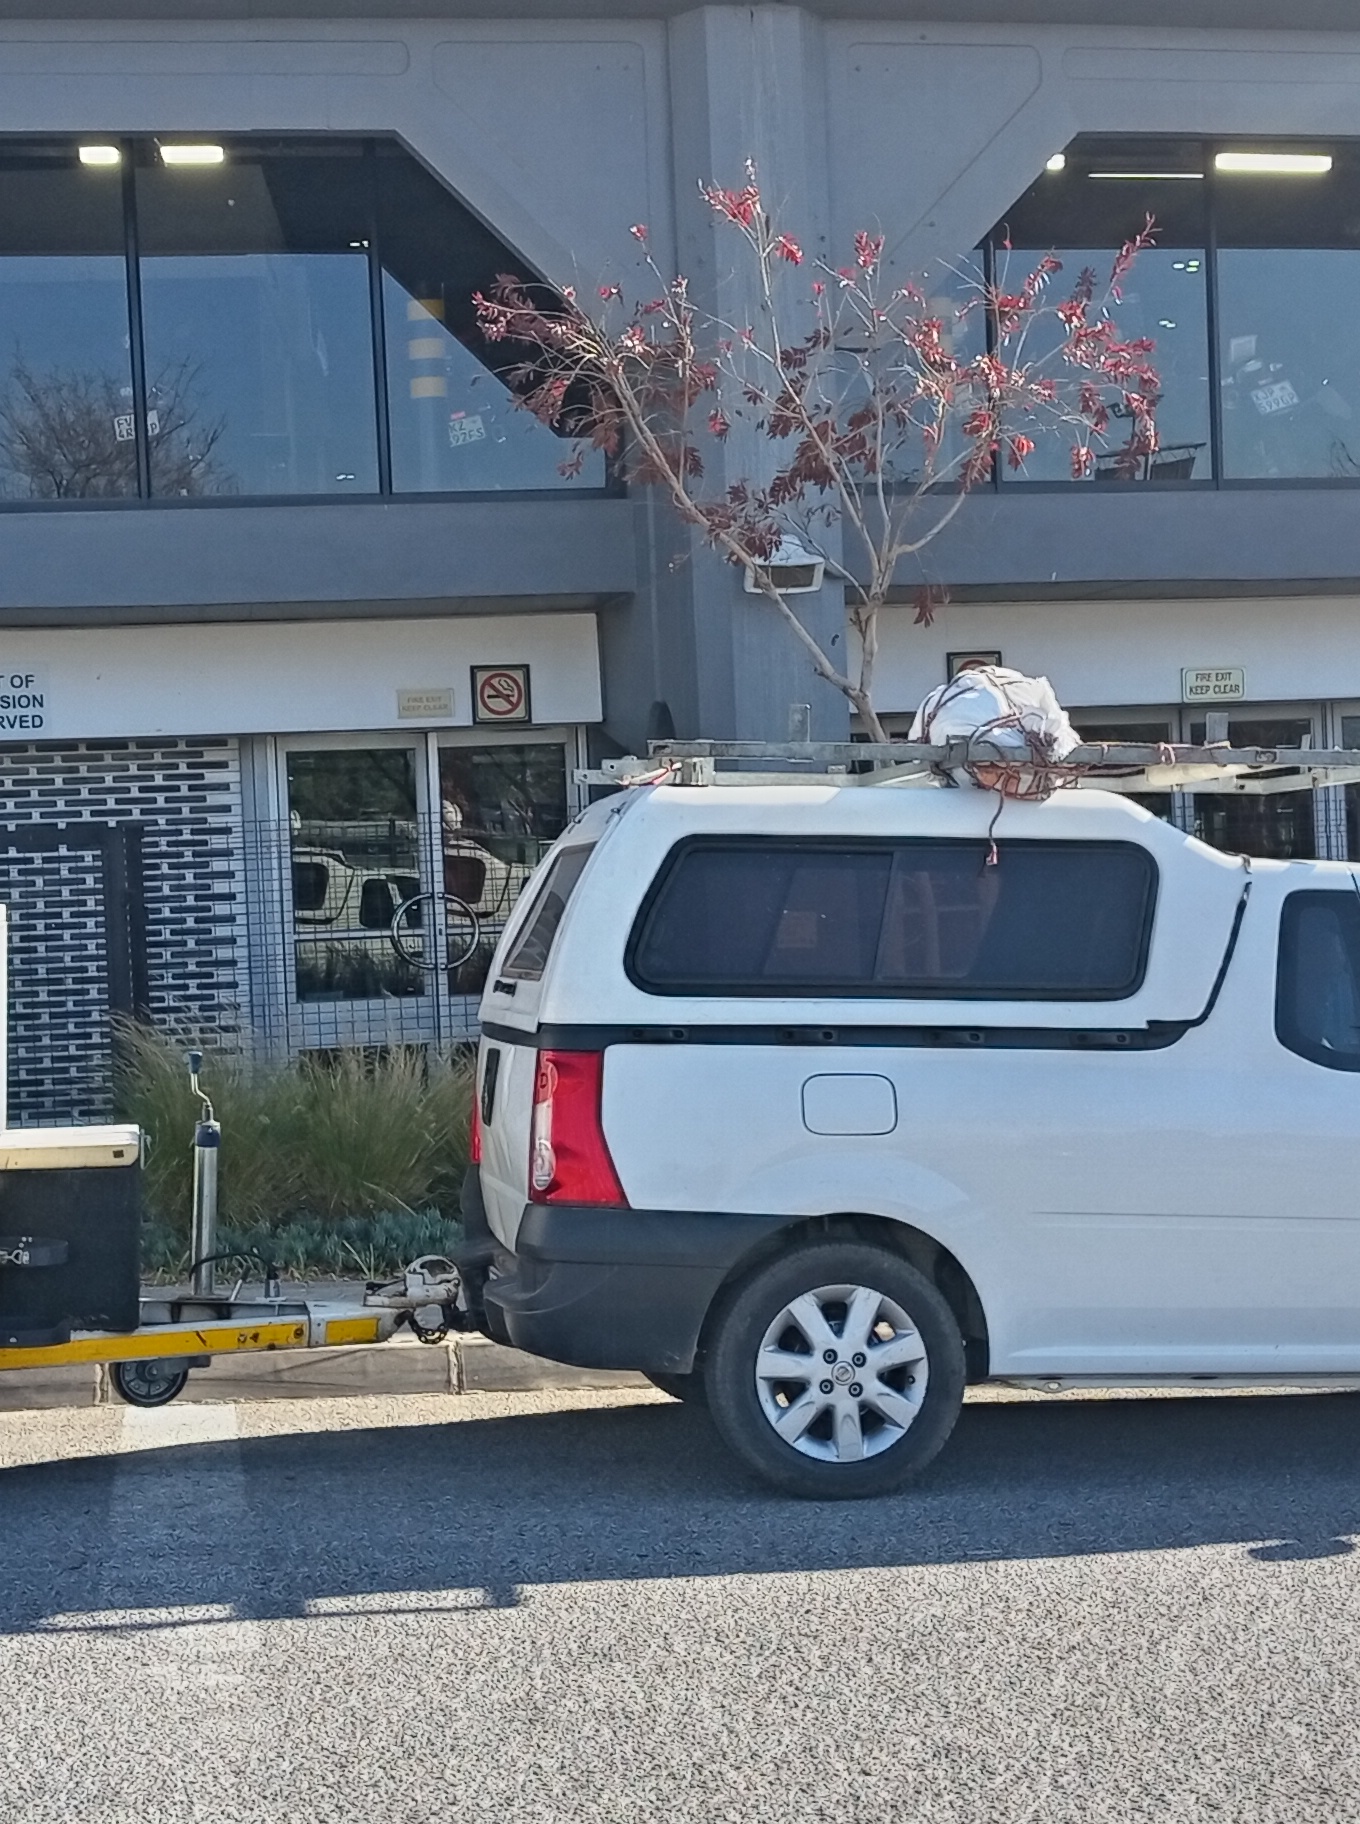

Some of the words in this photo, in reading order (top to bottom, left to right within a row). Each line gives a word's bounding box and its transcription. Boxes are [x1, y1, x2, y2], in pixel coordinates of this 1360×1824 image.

[10, 674, 35, 689] OF
[1195, 673, 1212, 682] FIRE
[1215, 672, 1232, 682] EXIT
[1189, 685, 1210, 695] KEEP
[1213, 684, 1240, 694] CLEAR
